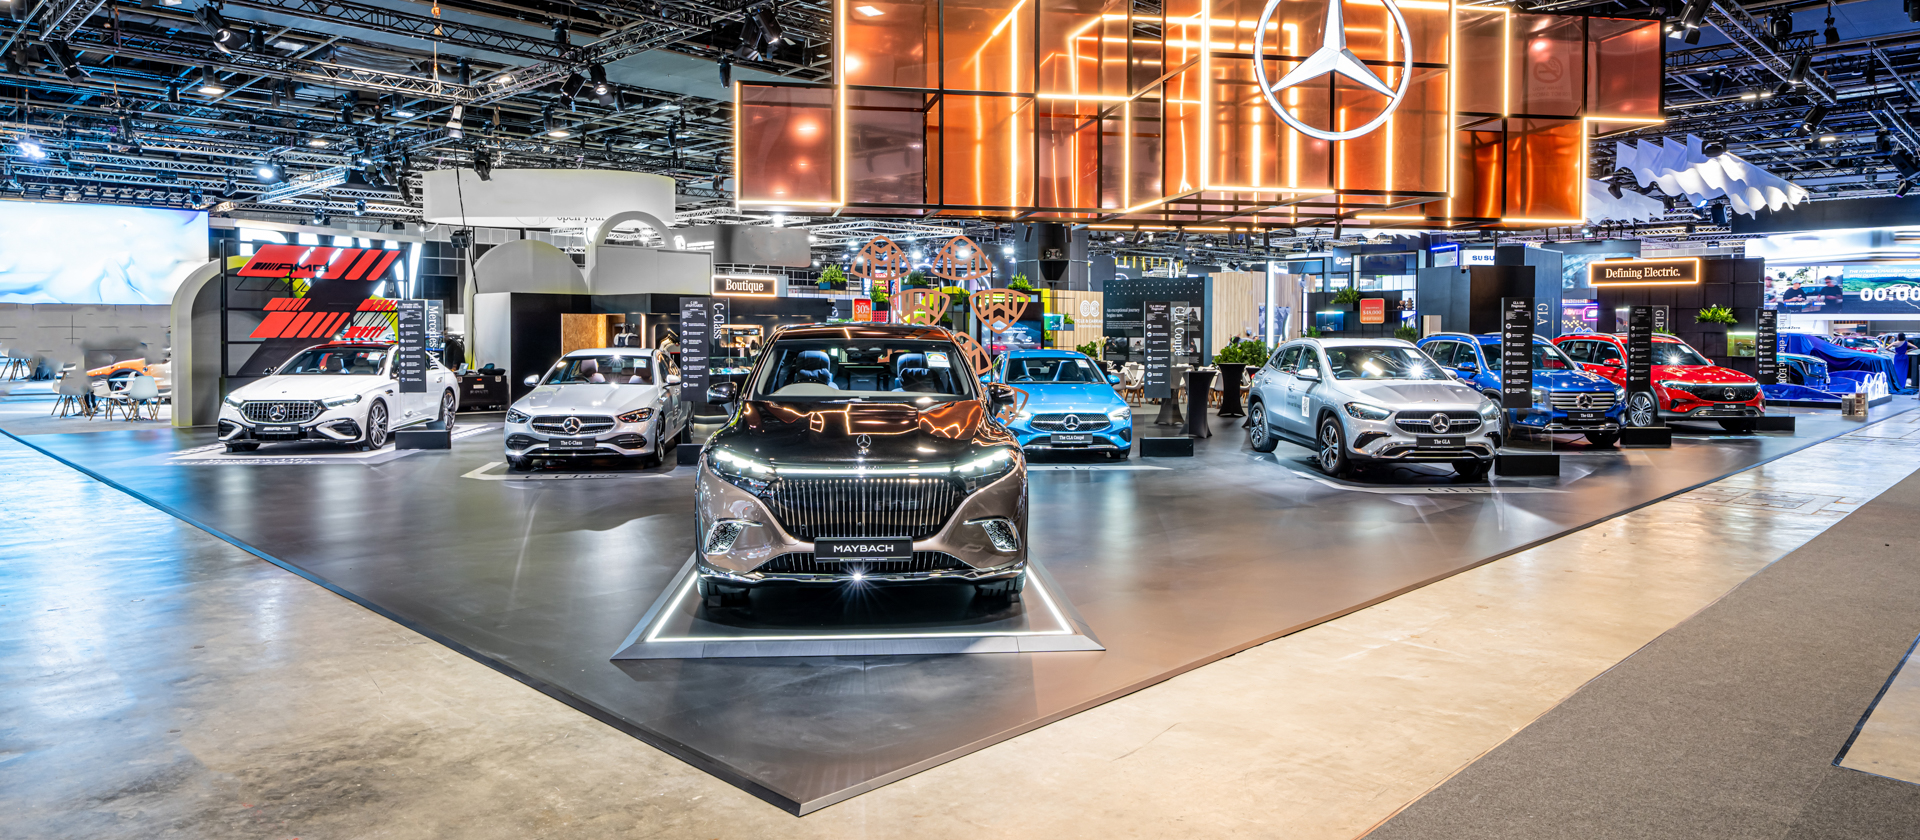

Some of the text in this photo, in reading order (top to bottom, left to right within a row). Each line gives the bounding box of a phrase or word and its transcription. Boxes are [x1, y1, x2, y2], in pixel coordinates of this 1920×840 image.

[1605, 266, 1681, 279] Defining Electric.
[725, 279, 764, 293] Boutique
[713, 302, 725, 339] C-Class
[1536, 303, 1549, 326] GLA
[1655, 309, 1665, 328] GLB
[1172, 306, 1185, 356] CLA Coupé
[833, 545, 894, 553] MAYBACH
